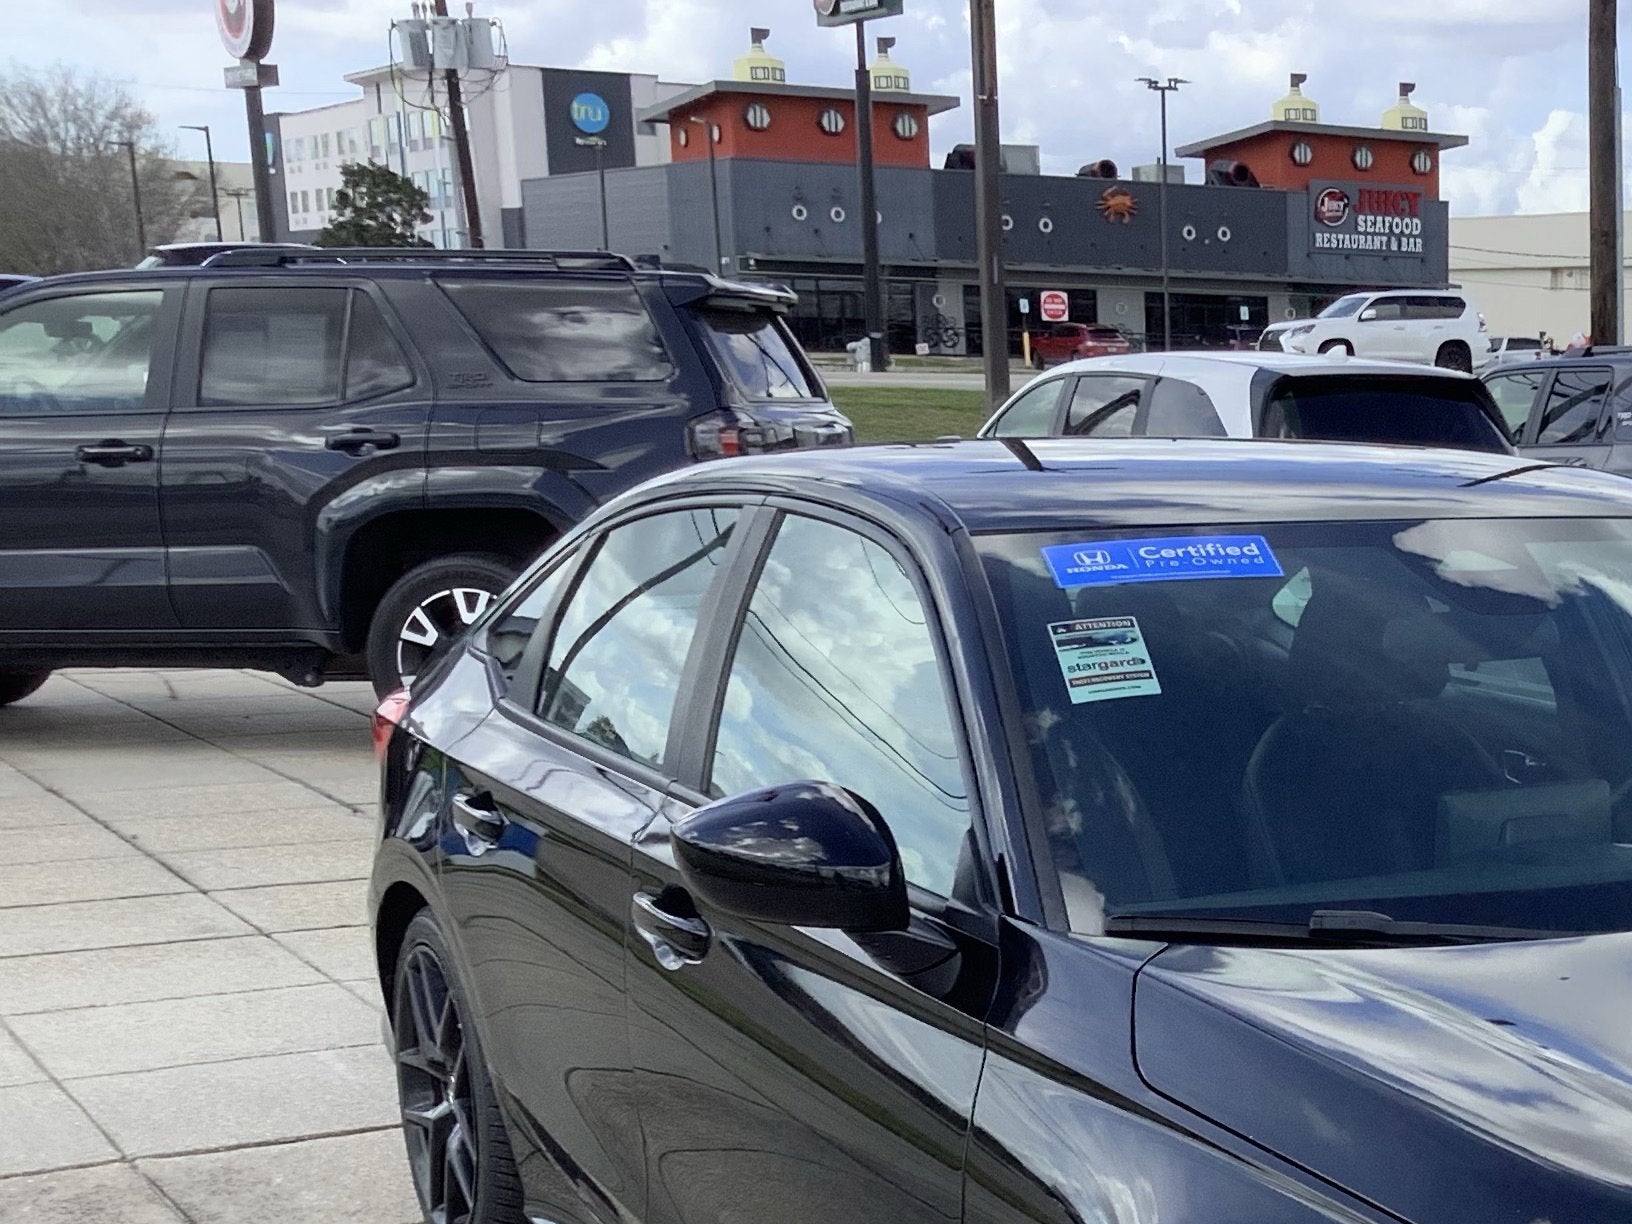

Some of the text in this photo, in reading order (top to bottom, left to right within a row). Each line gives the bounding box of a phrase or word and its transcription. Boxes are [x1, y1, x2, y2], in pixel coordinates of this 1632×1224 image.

[572, 100, 601, 121] tru
[1353, 189, 1421, 217] JUICY
[1357, 215, 1421, 235] SEAFOOD
[1315, 233, 1423, 253] RESTAURANT & BAR
[1138, 543, 1261, 559] Certified
[1066, 564, 1129, 574] HONDA
[1145, 556, 1264, 568] Pre-Owned
[1074, 620, 1131, 631] ATTENTION
